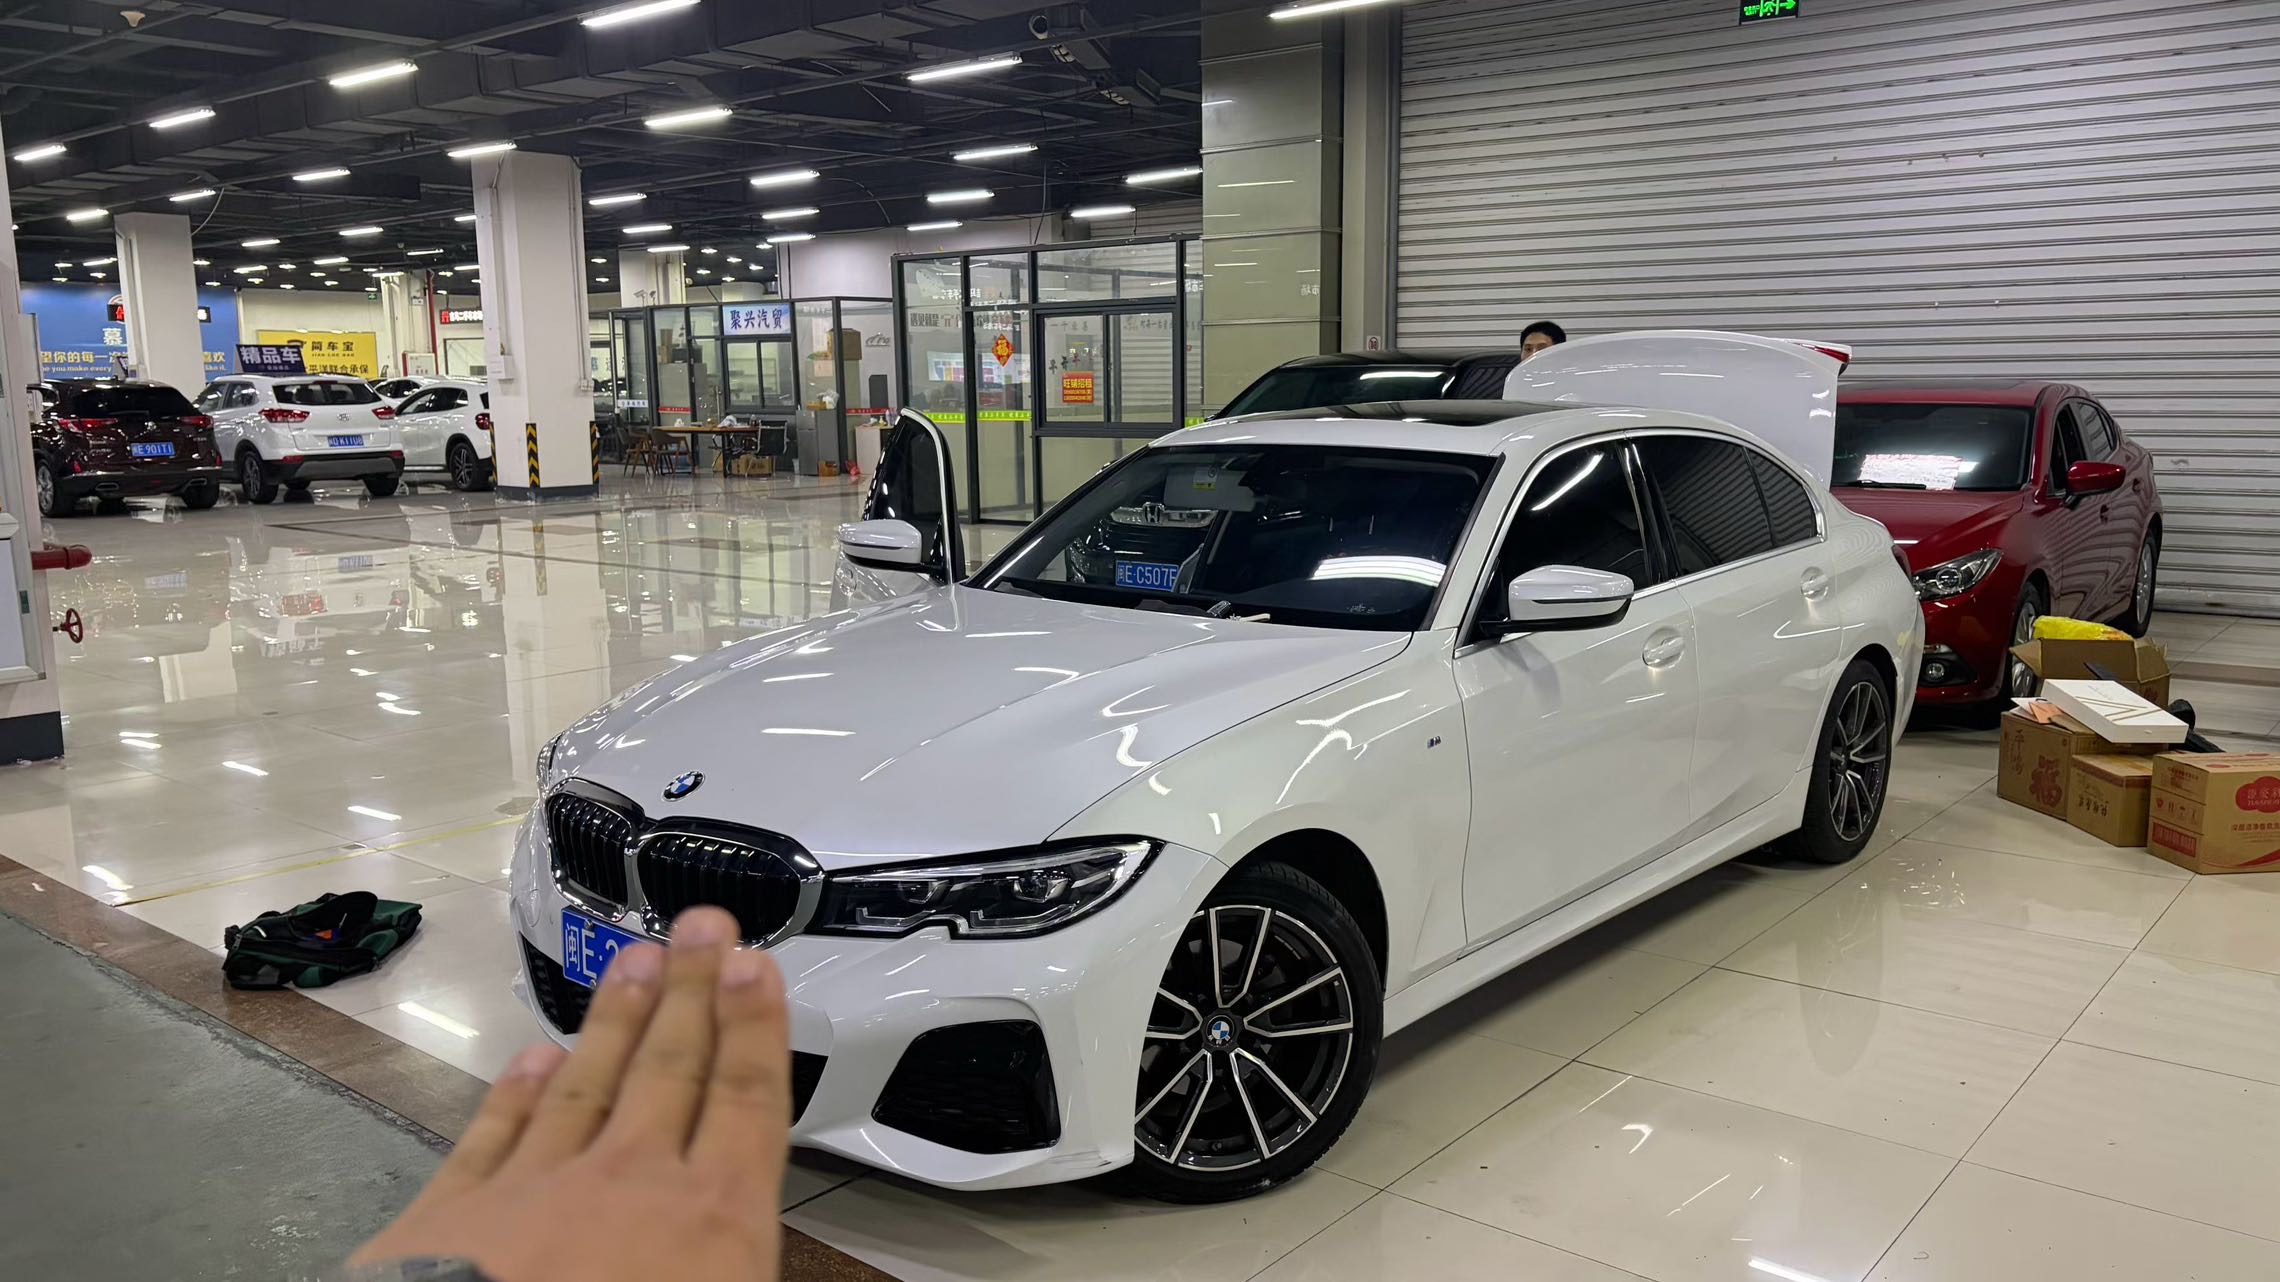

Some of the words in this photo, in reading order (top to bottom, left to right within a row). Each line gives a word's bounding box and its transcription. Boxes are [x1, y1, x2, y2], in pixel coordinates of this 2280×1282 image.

[730, 308, 783, 330] 聚兴汽贸
[240, 347, 301, 364] 精品车
[308, 364, 369, 374] 平洋联合承保
